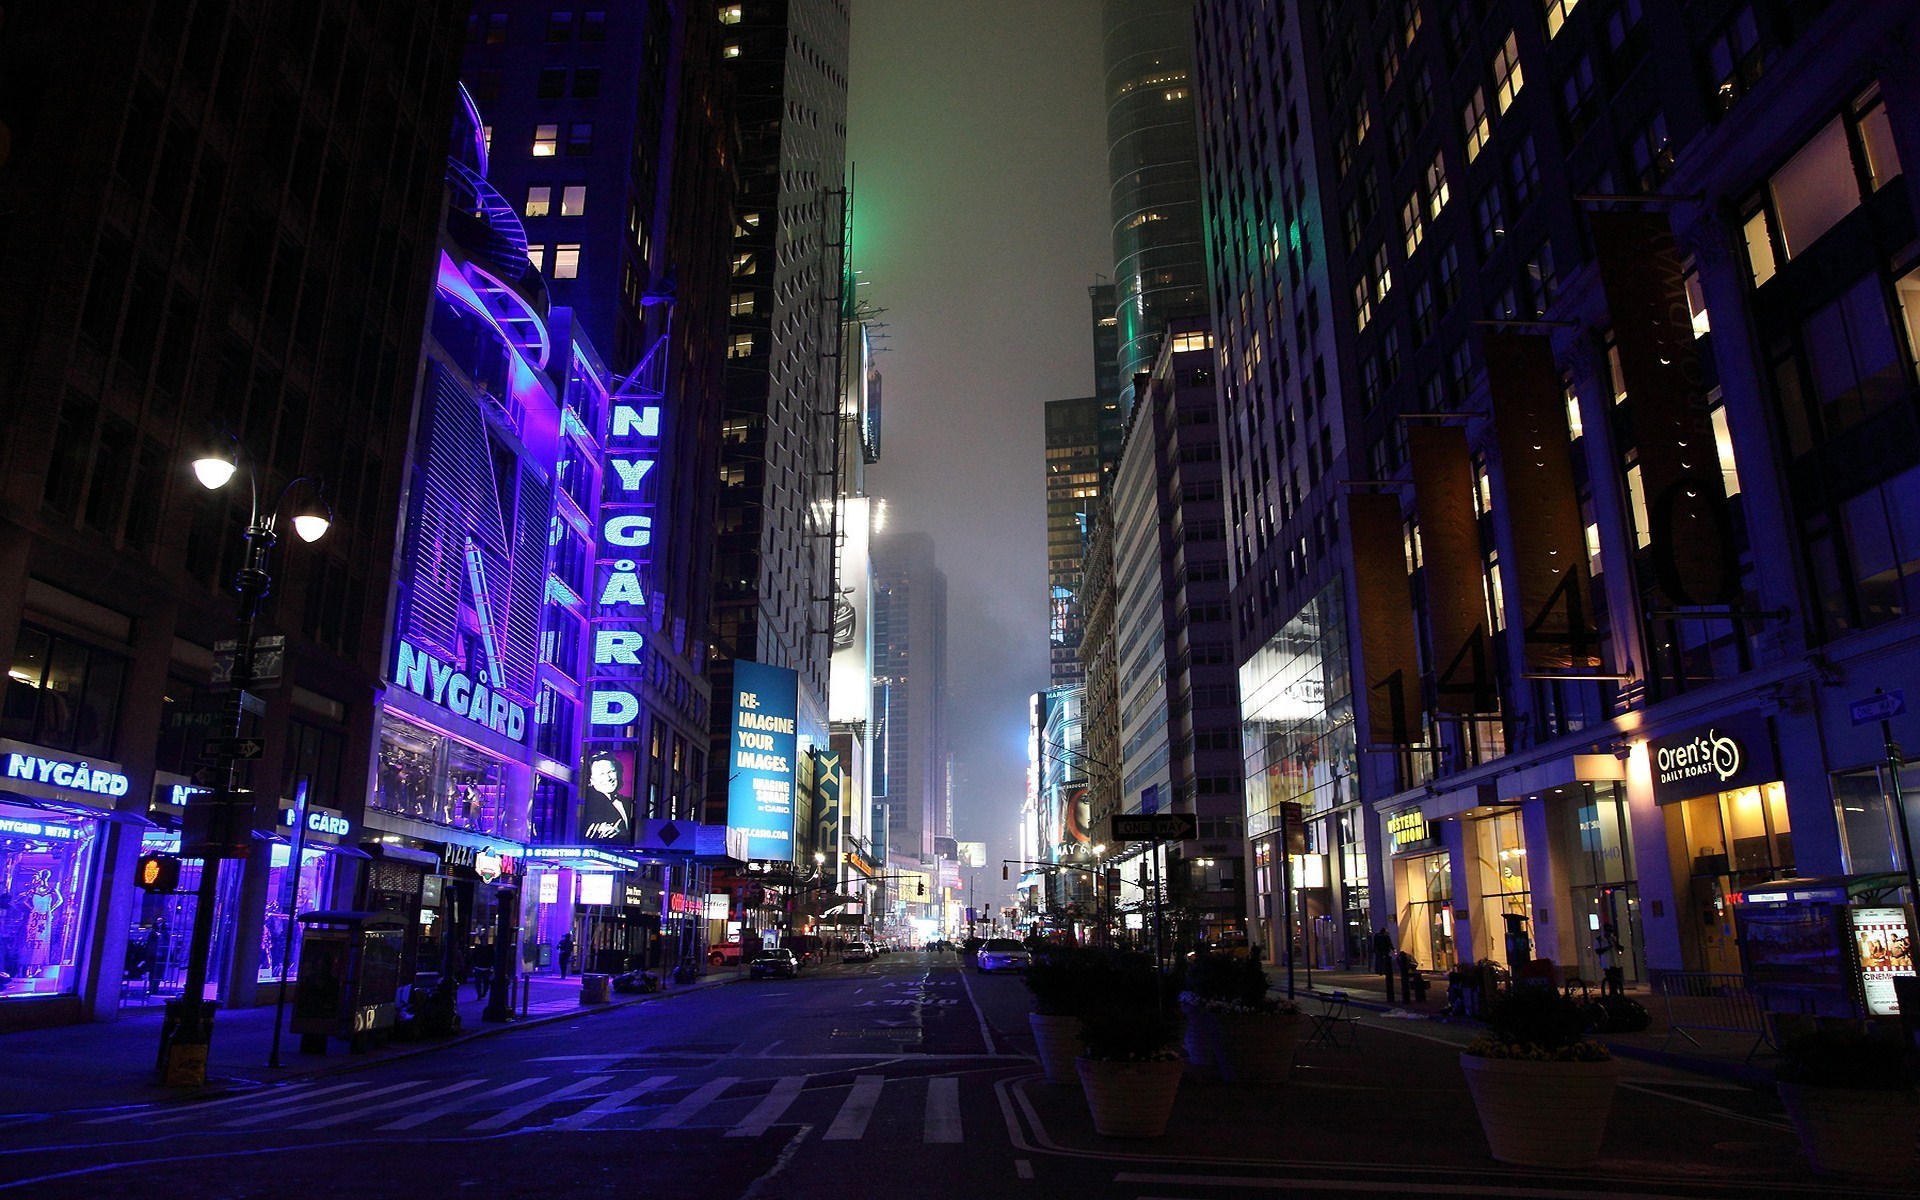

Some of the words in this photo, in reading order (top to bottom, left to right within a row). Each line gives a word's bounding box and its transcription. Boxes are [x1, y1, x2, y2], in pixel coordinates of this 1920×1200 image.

[590, 405, 661, 725] NYGÅRD
[396, 640, 525, 741] NYGÅRD
[740, 691, 761, 709] RE-
[739, 712, 794, 735] IMAGINE
[738, 731, 774, 752] YOUR
[737, 751, 790, 773] IMAGES.
[1657, 736, 1711, 771] Oren's
[8, 753, 129, 797] NYGÅRD
[1660, 767, 1683, 784] DAILY
[1684, 761, 1713, 778] ROAST
[752, 778, 790, 793] IMAGING
[1124, 821, 1147, 834] ONE
[1156, 821, 1184, 834] WAY
[1396, 826, 1423, 845] UNION
[445, 842, 475, 868] PIZZA
